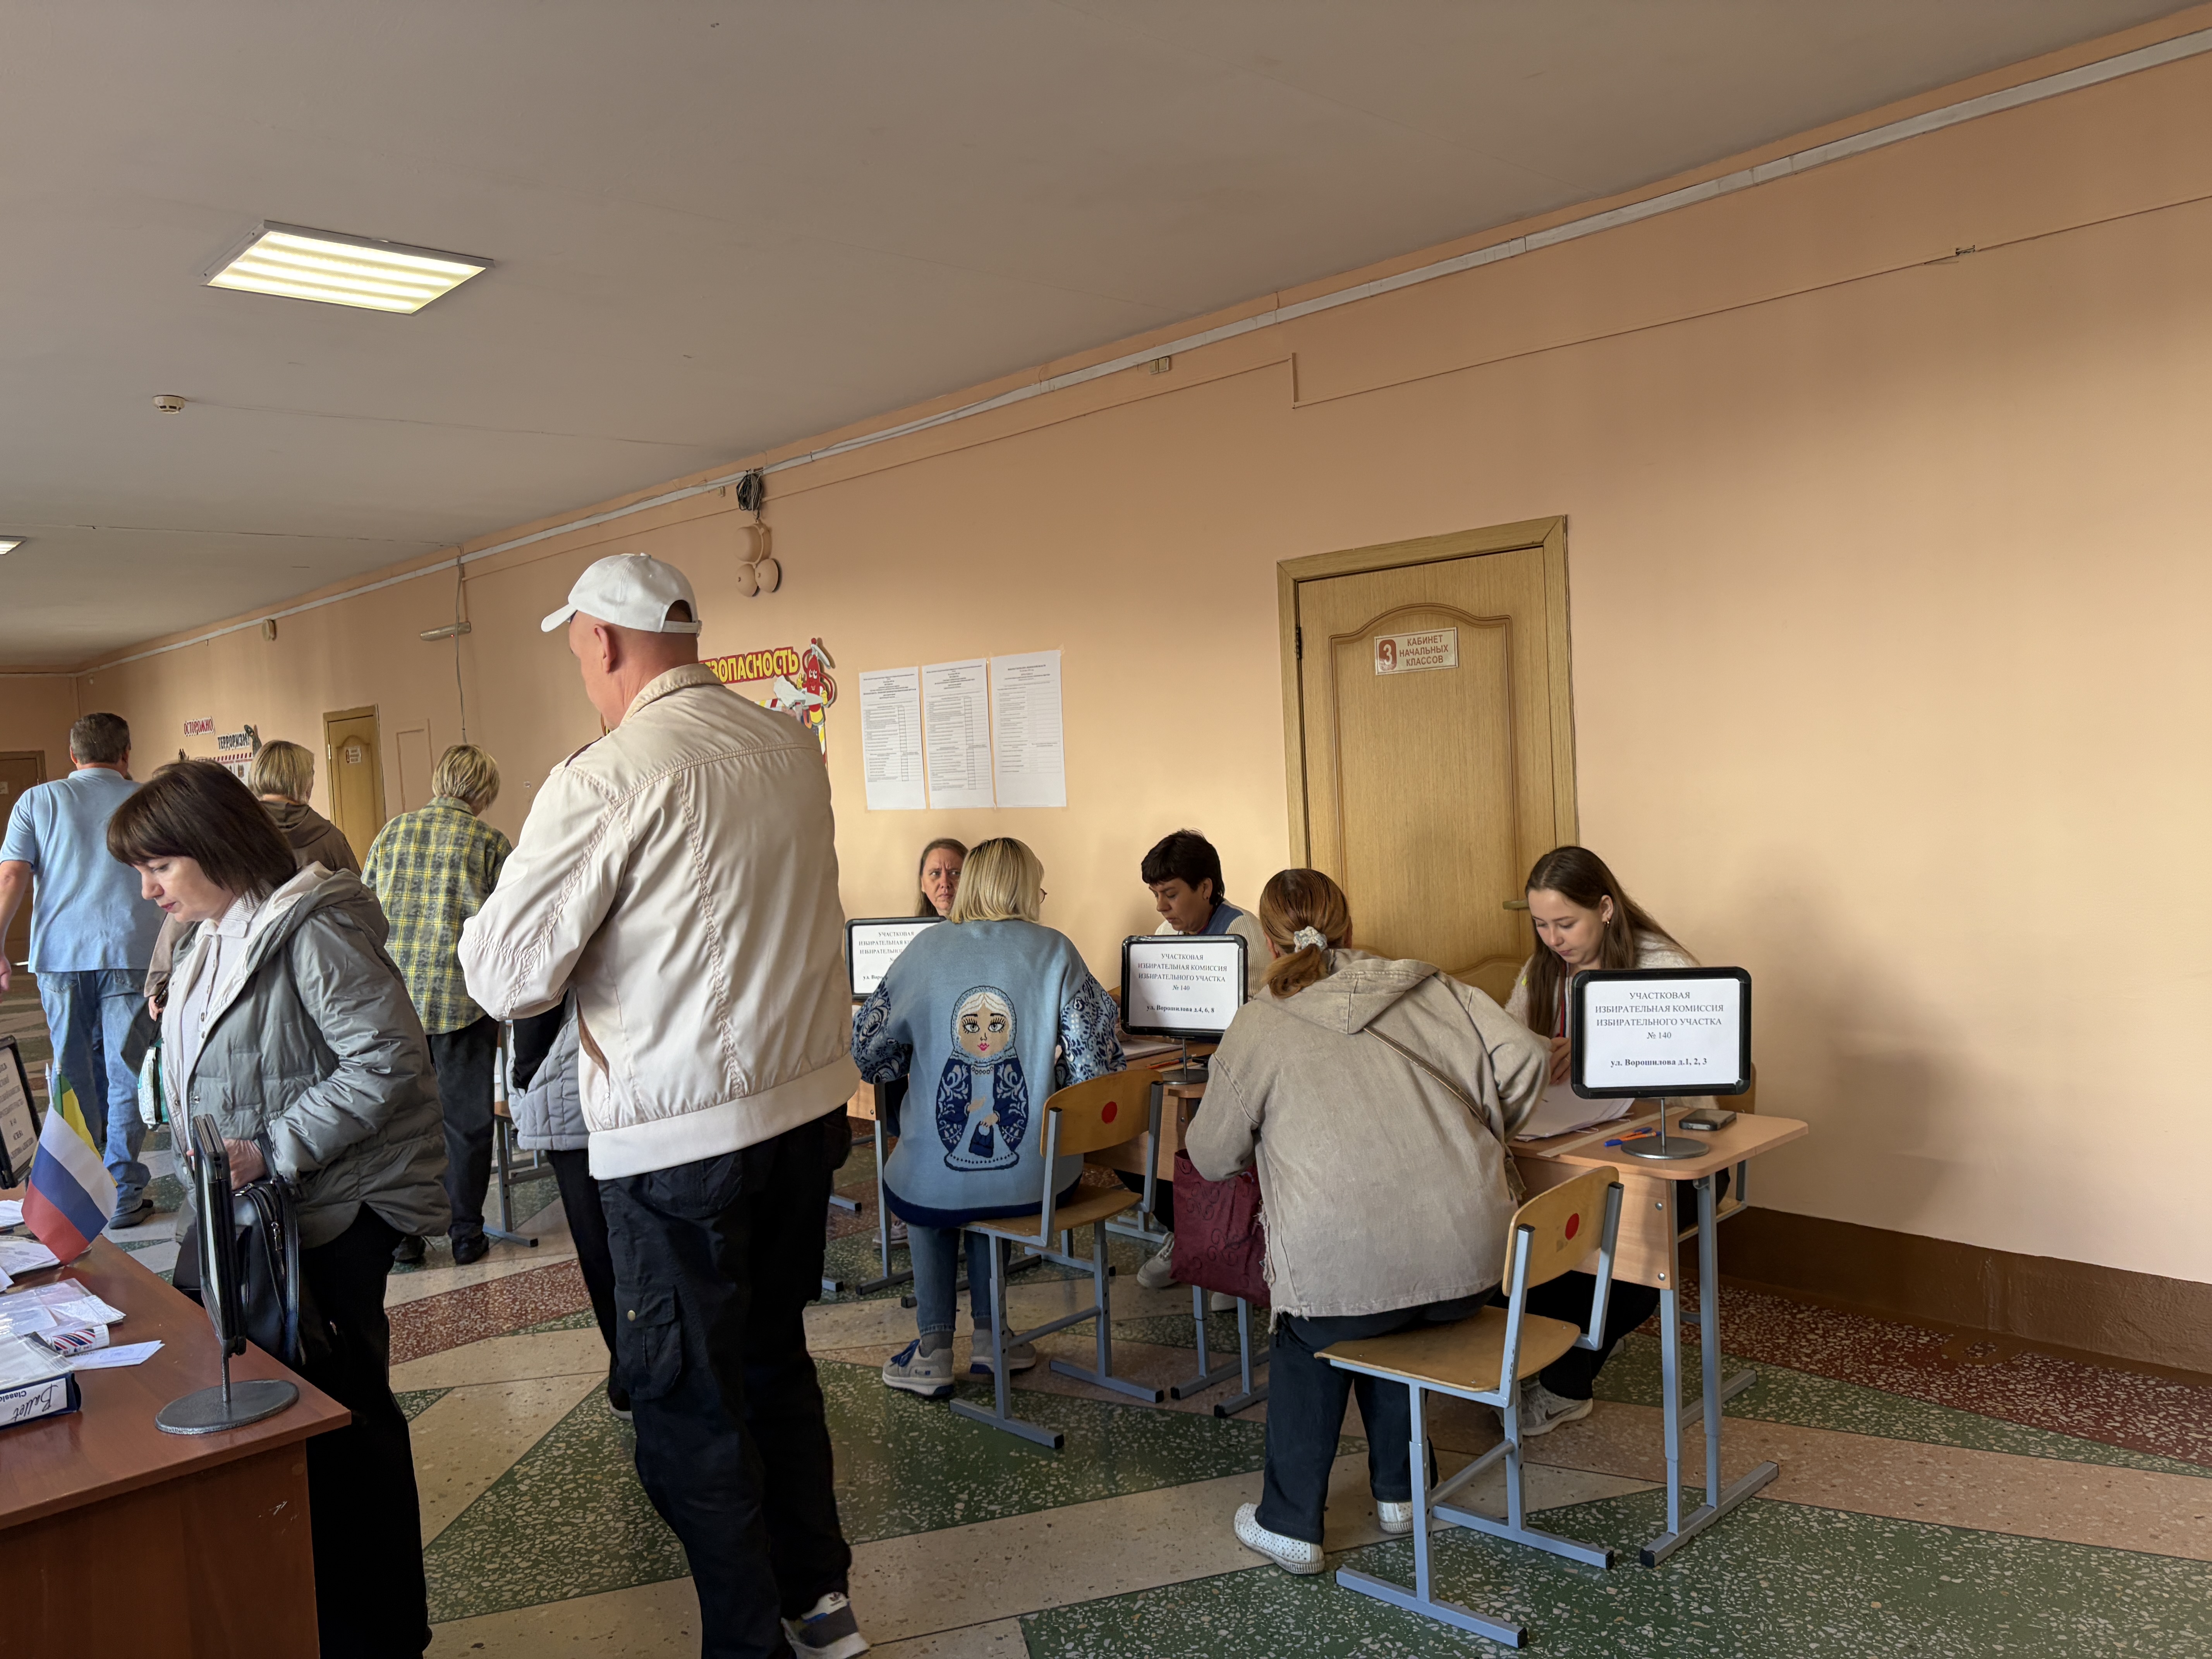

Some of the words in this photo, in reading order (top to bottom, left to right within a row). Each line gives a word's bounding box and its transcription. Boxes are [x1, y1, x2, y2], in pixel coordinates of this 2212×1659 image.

[1407, 635, 1443, 646] КАБИНЕТ
[1383, 644, 1393, 665] 3
[1400, 644, 1448, 657] НАЧАЛЬНЫХ
[1407, 655, 1443, 666] КЛАССОВ
[1625, 1059, 1676, 1067] Ворошилова
[11, 1384, 58, 1422] Ballet
